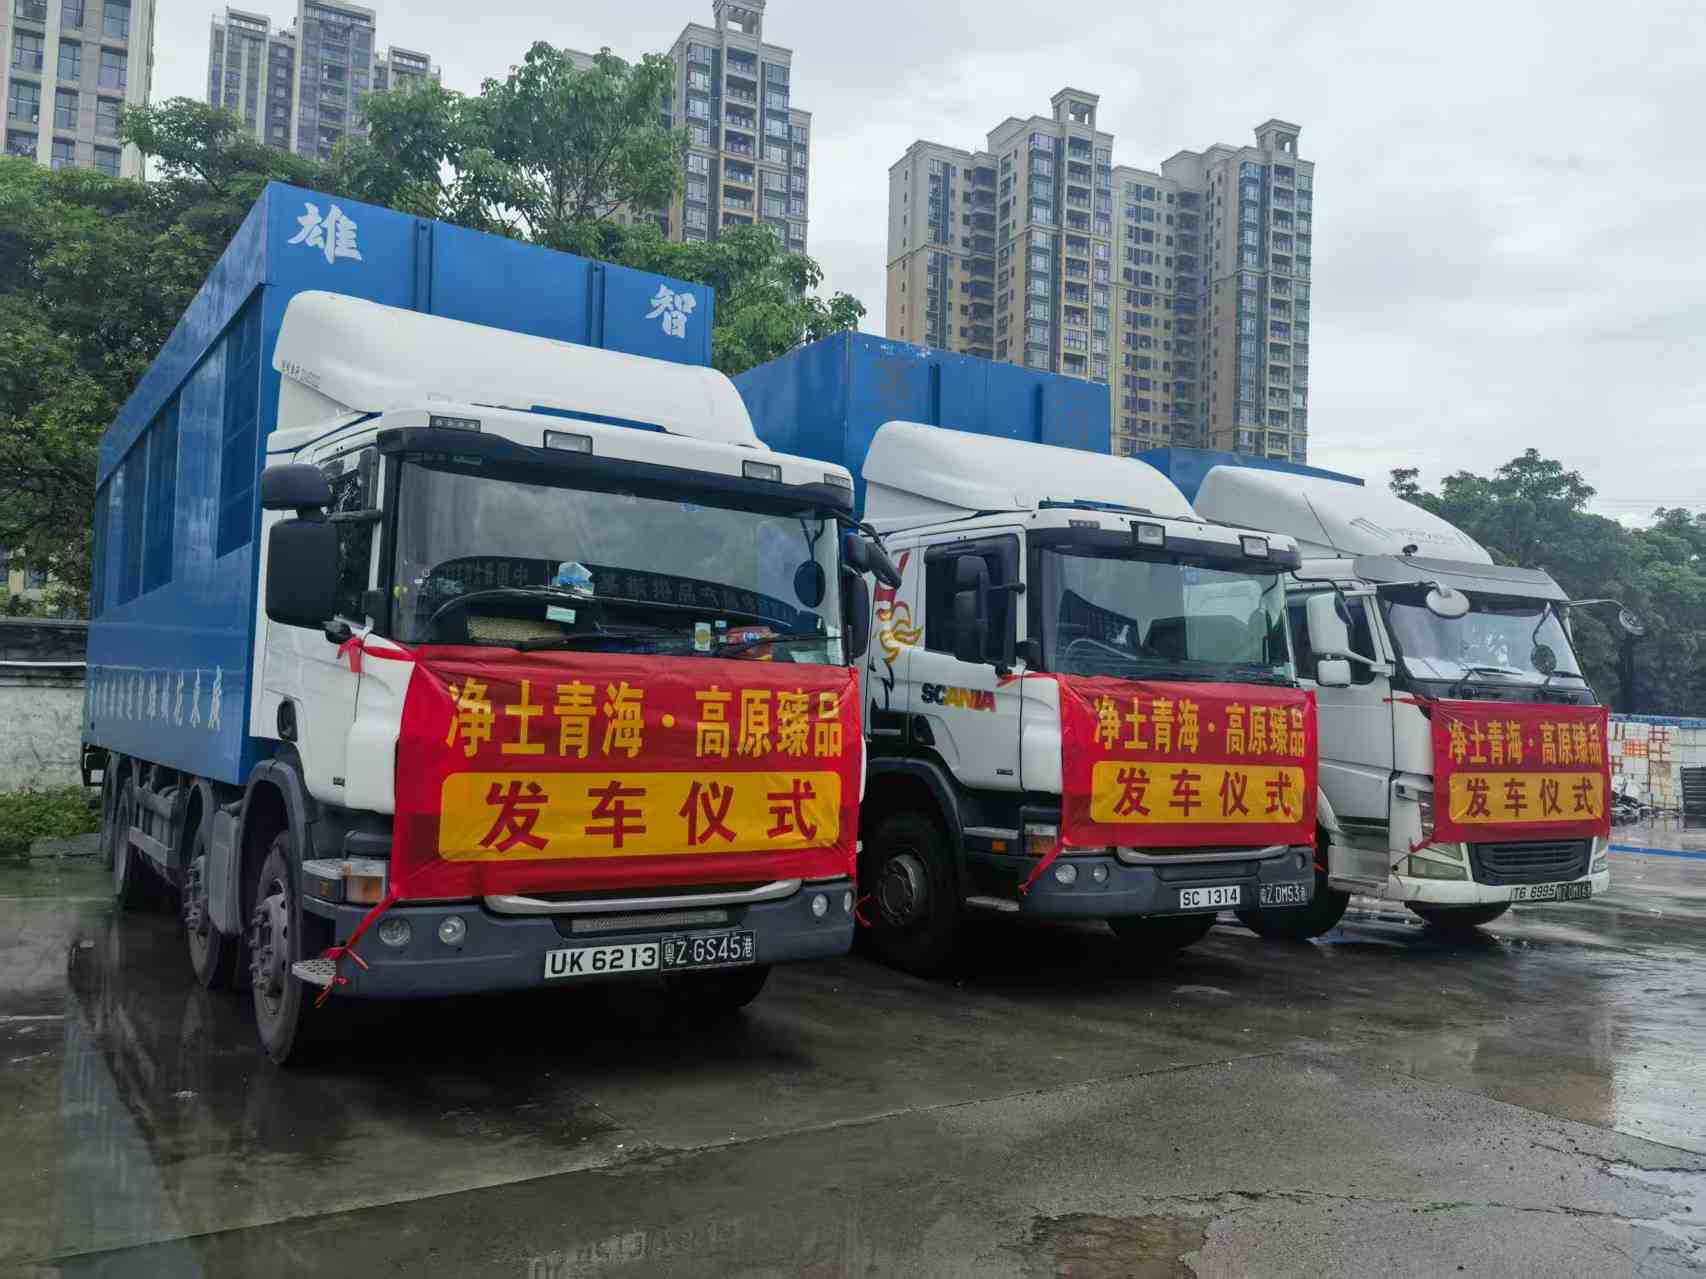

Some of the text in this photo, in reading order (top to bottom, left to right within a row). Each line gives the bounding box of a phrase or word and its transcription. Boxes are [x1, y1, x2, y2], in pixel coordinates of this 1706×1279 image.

[288, 202, 697, 339] 雄 智
[921, 682, 997, 713] SCANIA
[1112, 767, 1293, 817] 发车仪式
[1466, 776, 1594, 818] 发车仪式
[478, 778, 818, 852] 发车仪式
[1182, 888, 1238, 906] SC 1314
[1514, 887, 1526, 899] TG
[550, 946, 656, 975] UK 6213
